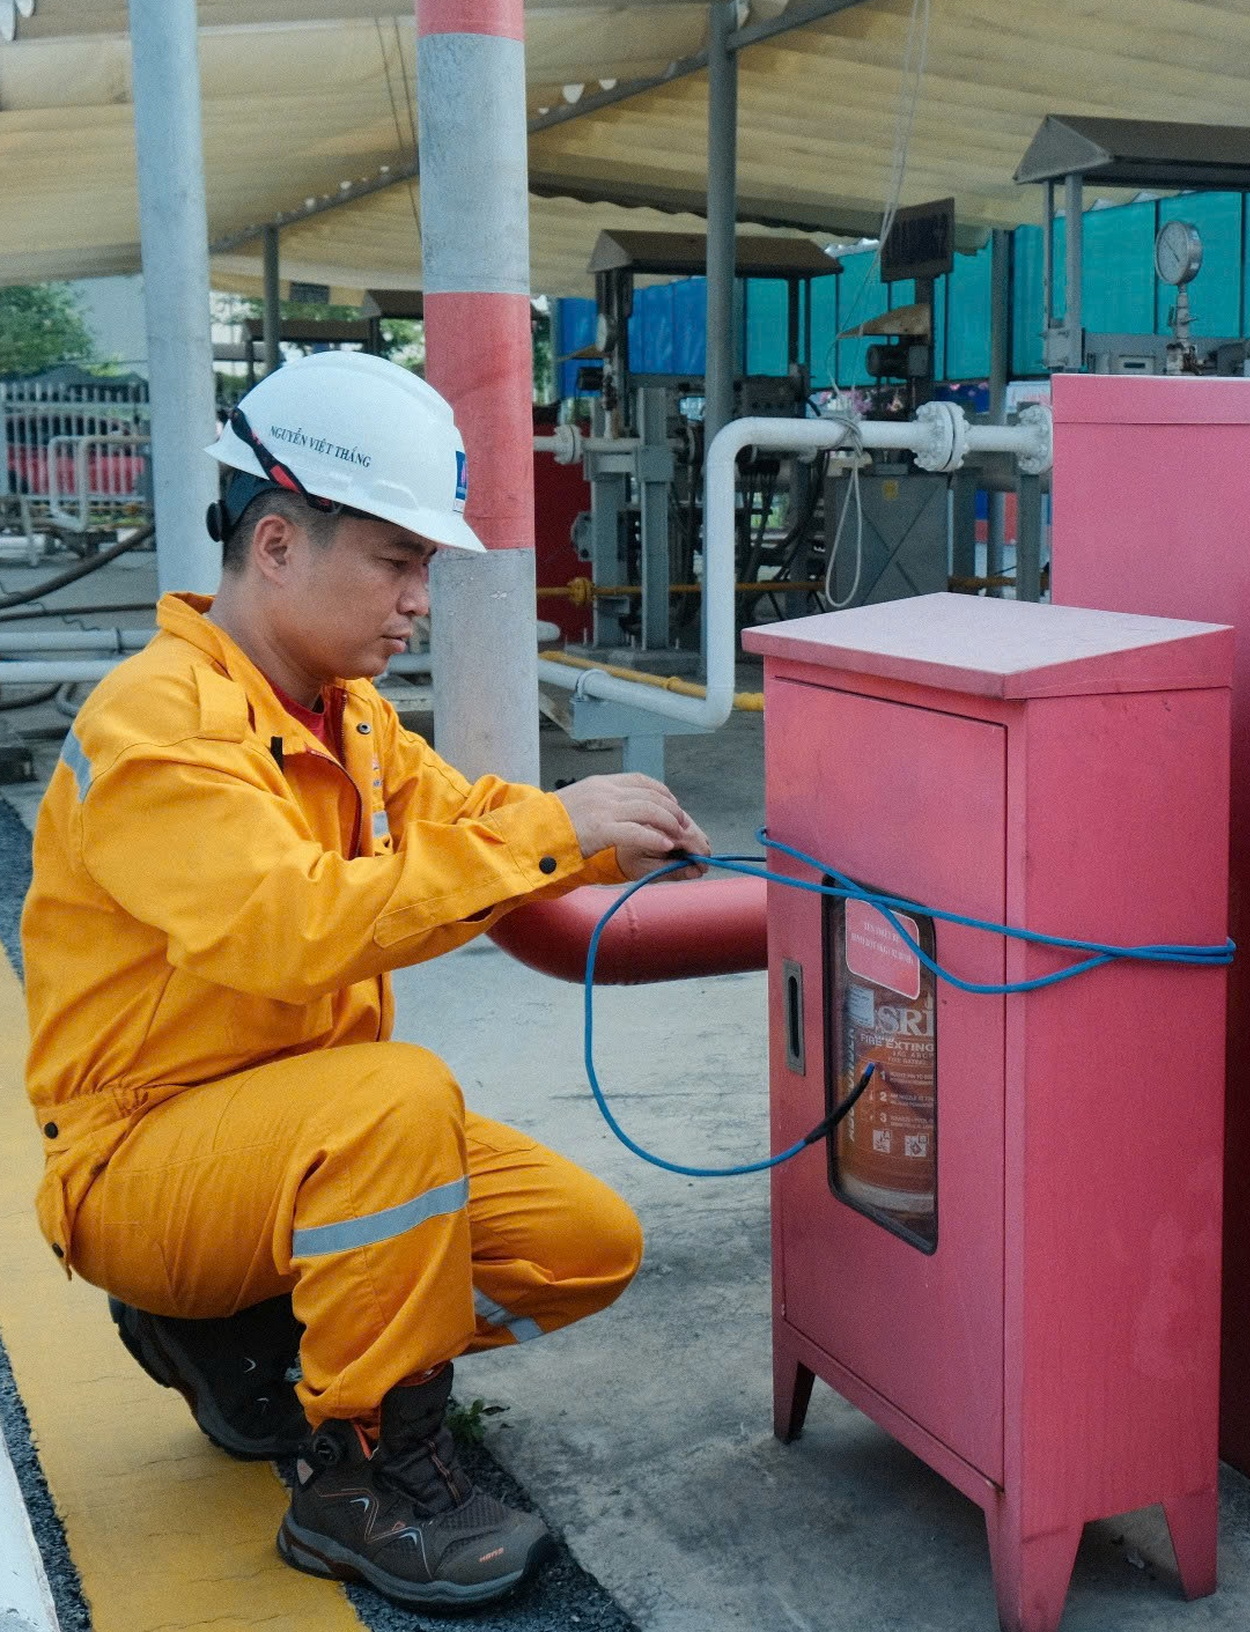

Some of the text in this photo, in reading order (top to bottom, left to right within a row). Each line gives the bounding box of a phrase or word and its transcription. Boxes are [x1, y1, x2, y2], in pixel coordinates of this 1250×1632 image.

[269, 425, 308, 447] NGUYỄN
[309, 437, 334, 455] VIỆT
[860, 1033, 883, 1047] FIRE
[879, 1091, 887, 1102] 2
[879, 1112, 887, 1123] 3
